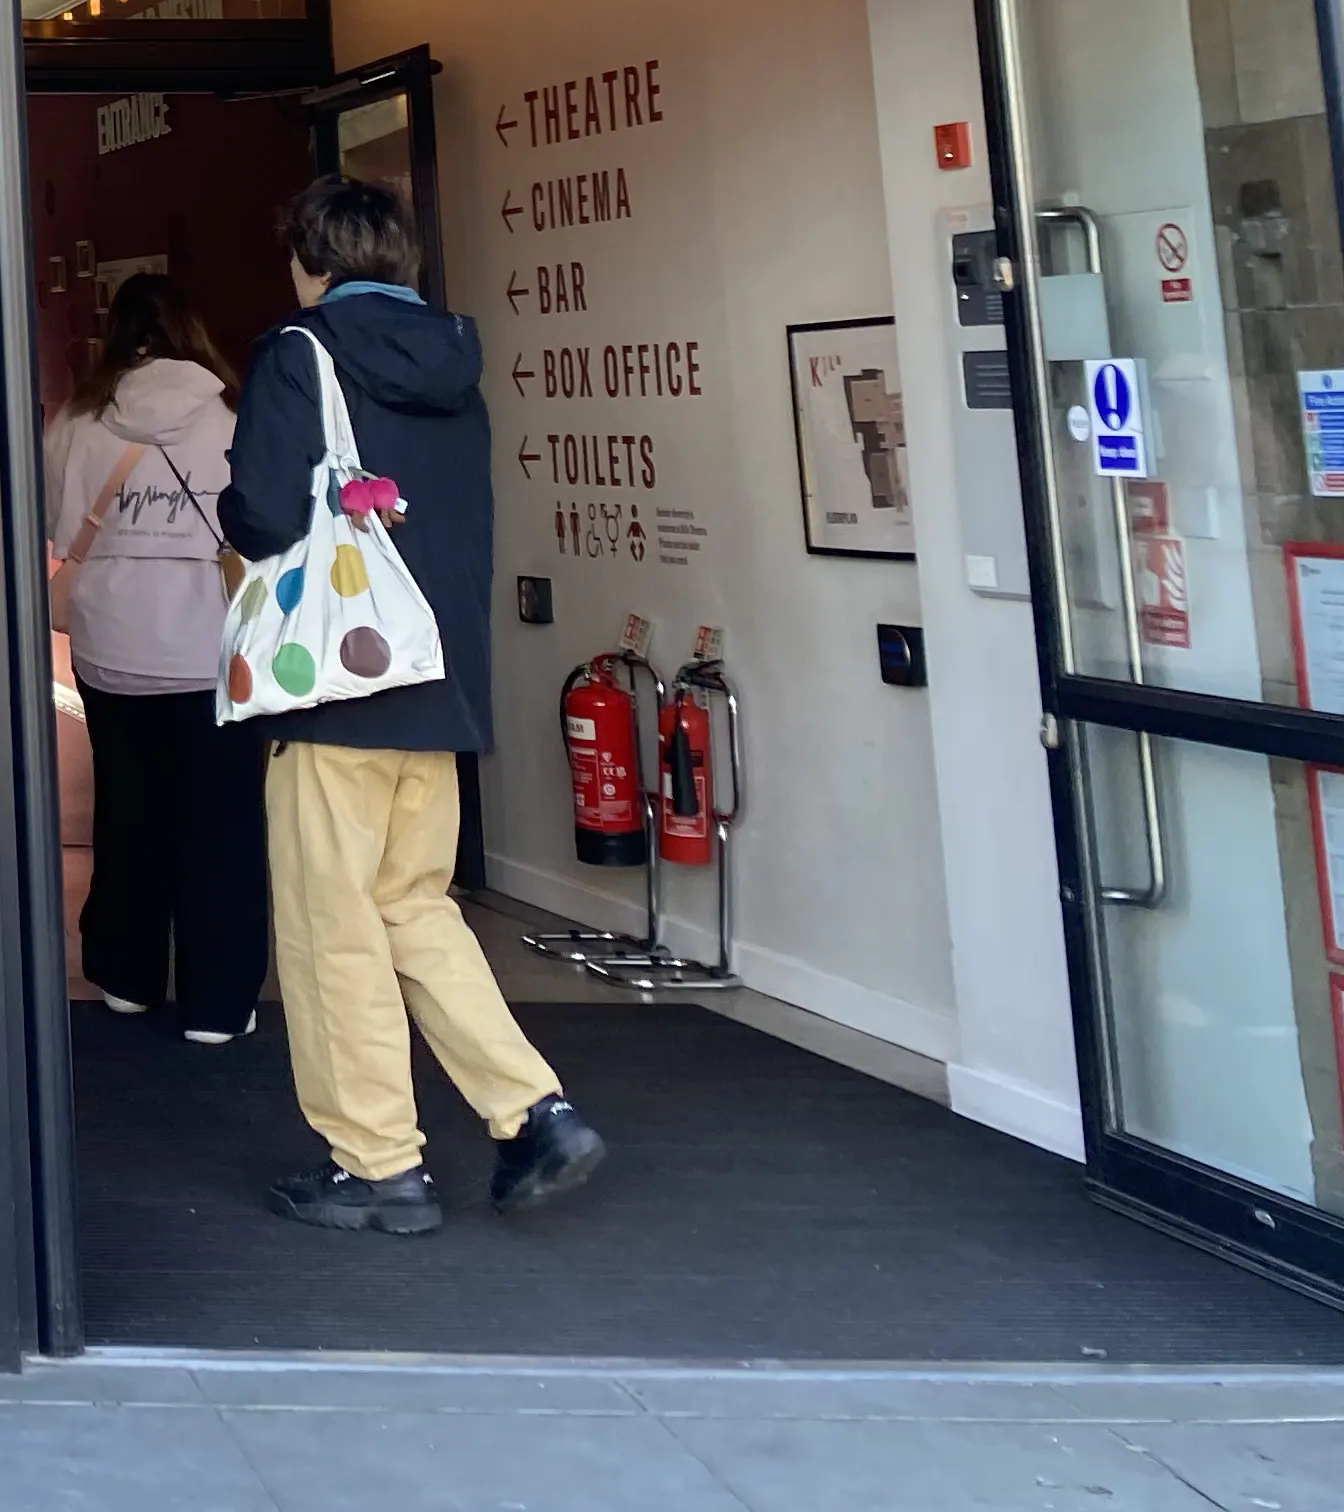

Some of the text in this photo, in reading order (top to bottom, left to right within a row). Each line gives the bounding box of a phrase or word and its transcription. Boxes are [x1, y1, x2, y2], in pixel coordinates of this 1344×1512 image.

[97, 90, 173, 155] ENTRANCE
[523, 59, 664, 148] THEATRE
[530, 167, 632, 232] CINEMA
[537, 261, 587, 315] BAR
[543, 341, 702, 399] BOX OFFICE
[547, 433, 656, 489] TOILETS
